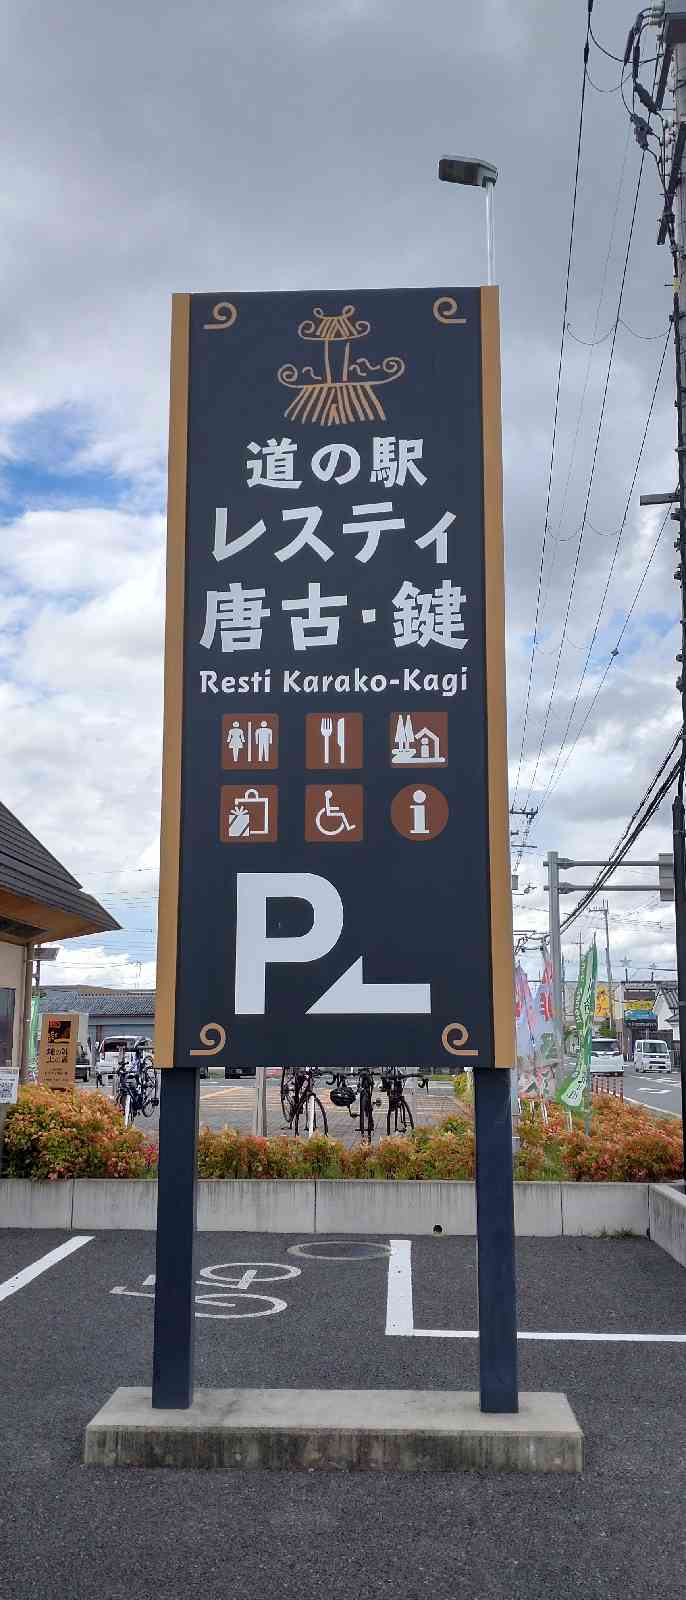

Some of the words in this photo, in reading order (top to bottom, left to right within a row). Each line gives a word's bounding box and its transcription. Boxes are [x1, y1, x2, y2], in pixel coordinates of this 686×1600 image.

[247, 437, 427, 489] 道の駅
[212, 502, 457, 563] レスティ
[200, 580, 469, 652] 唐古・鍵
[200, 669, 271, 693] Resti
[283, 667, 467, 696] Karako-Kagi
[235, 873, 343, 1014] P
